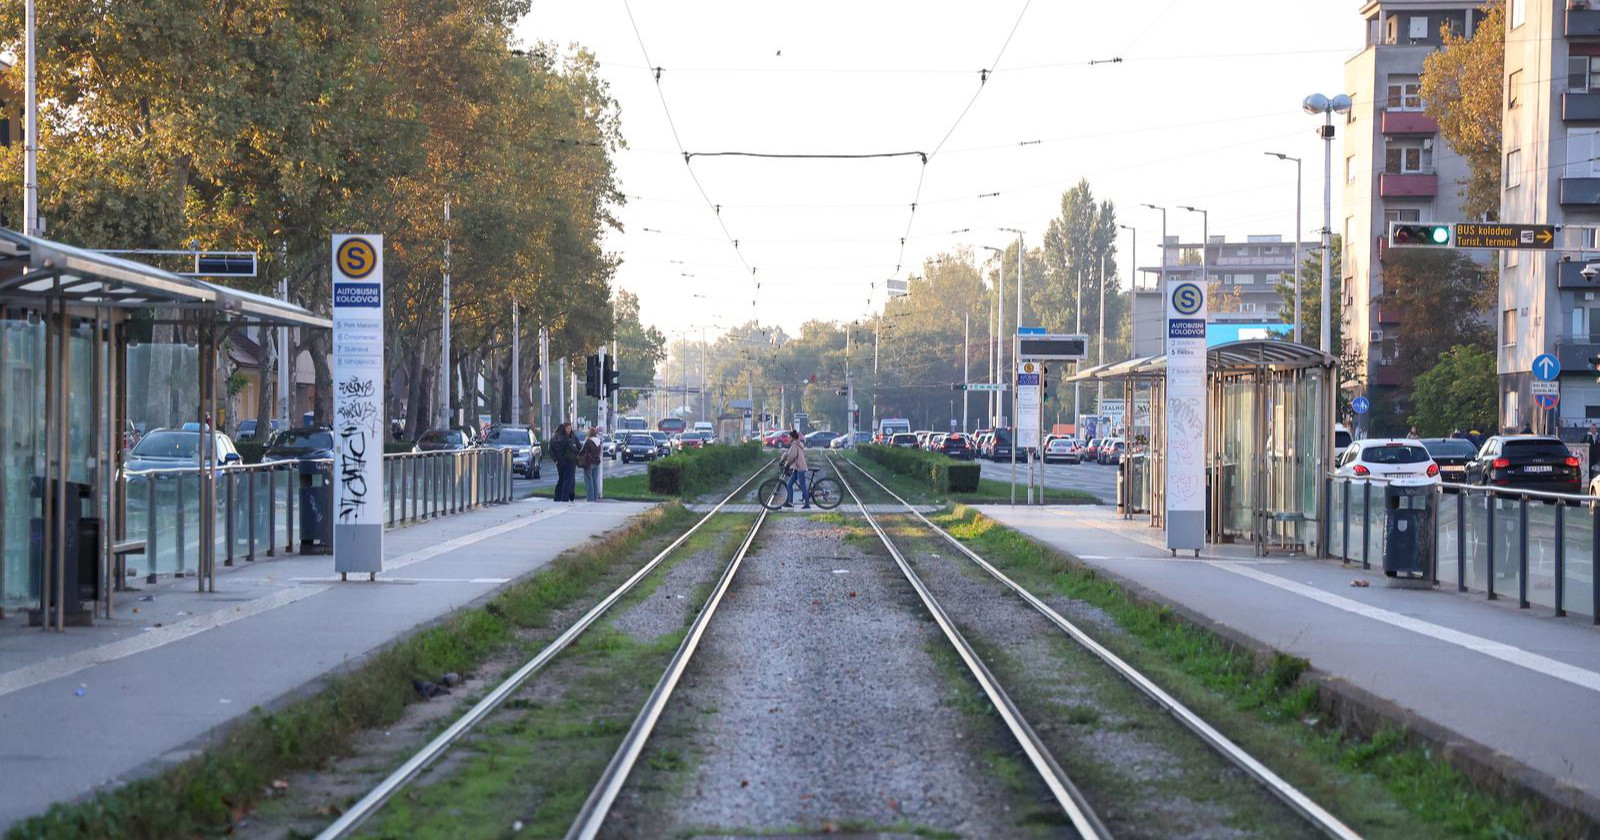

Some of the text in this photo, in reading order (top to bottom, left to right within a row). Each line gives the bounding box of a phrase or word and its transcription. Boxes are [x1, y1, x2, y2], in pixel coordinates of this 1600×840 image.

[1457, 224, 1513, 236] BUS kolodvor
[1457, 236, 1518, 247] Turist. terminal
[347, 247, 365, 269] S
[1181, 290, 1195, 308] S
